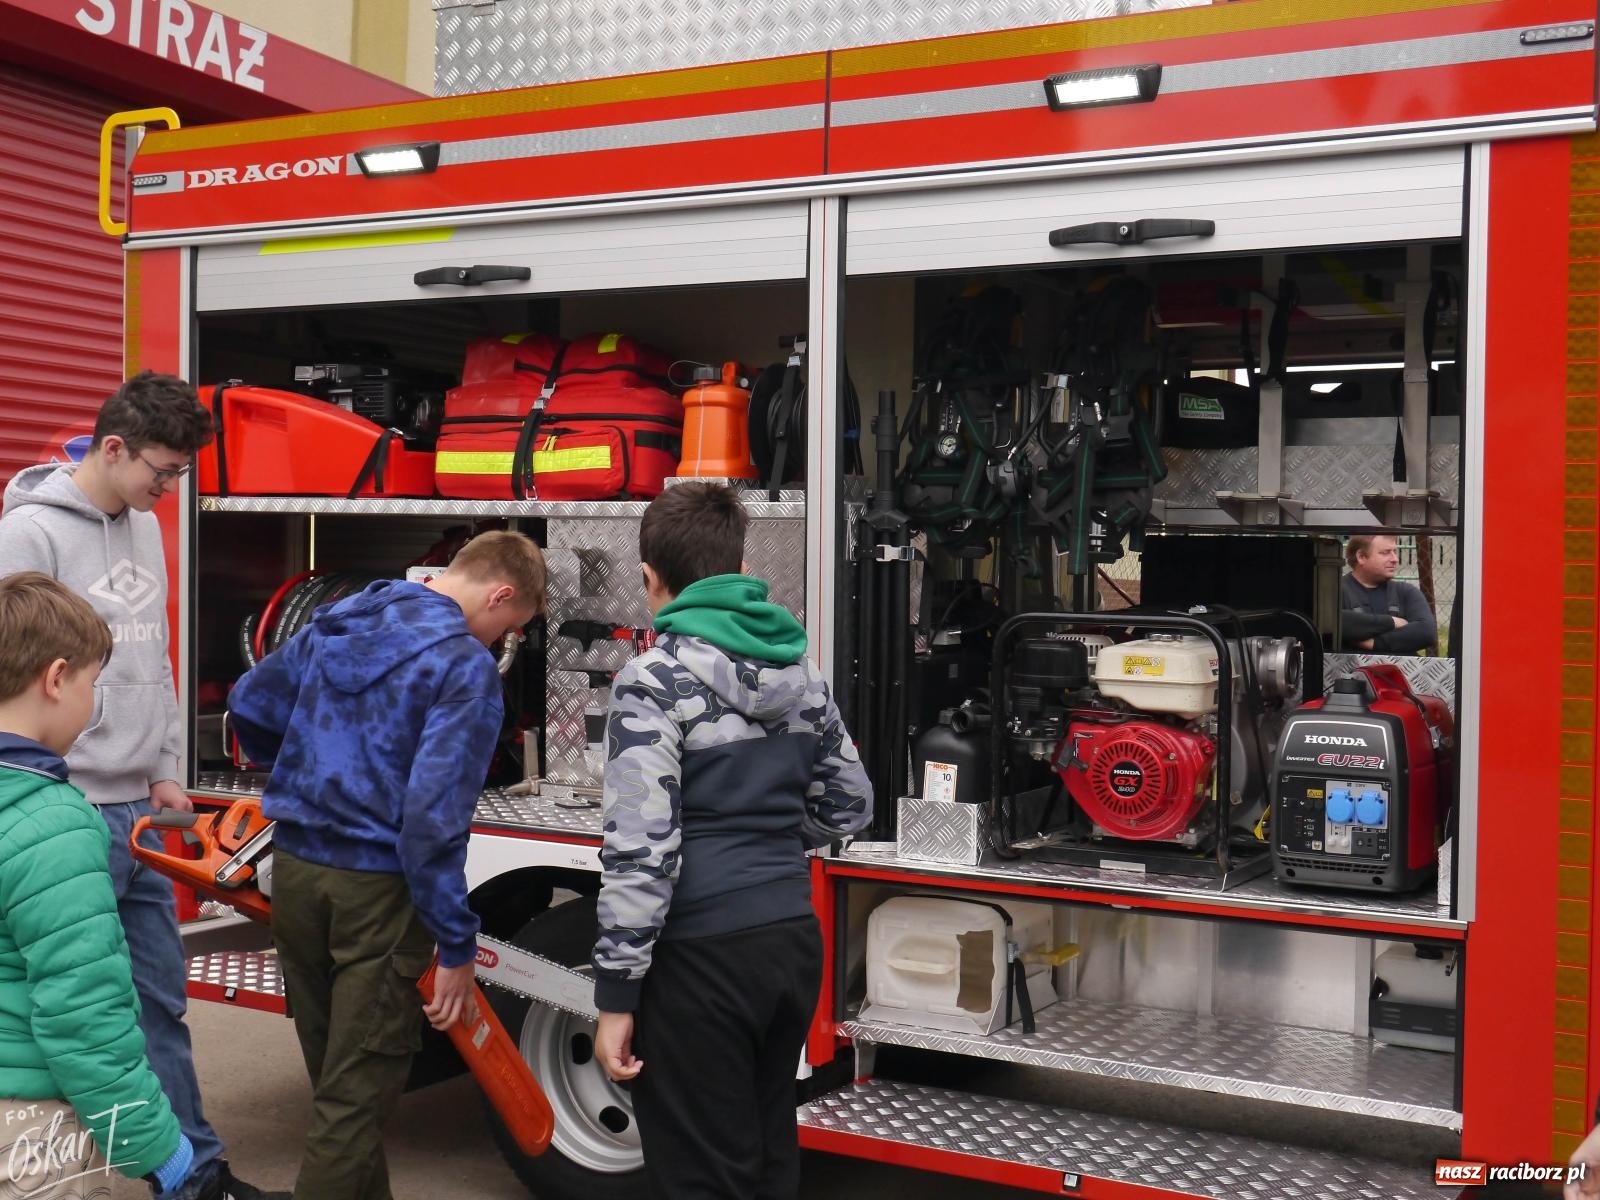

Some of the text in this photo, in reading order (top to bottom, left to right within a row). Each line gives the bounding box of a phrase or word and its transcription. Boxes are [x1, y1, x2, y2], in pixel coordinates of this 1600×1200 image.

[186, 155, 345, 189] DRAGON
[1183, 397, 1220, 411] MSA
[1303, 734, 1368, 747] HONDA
[942, 773, 952, 781] 10
[1114, 776, 1138, 786] GX
